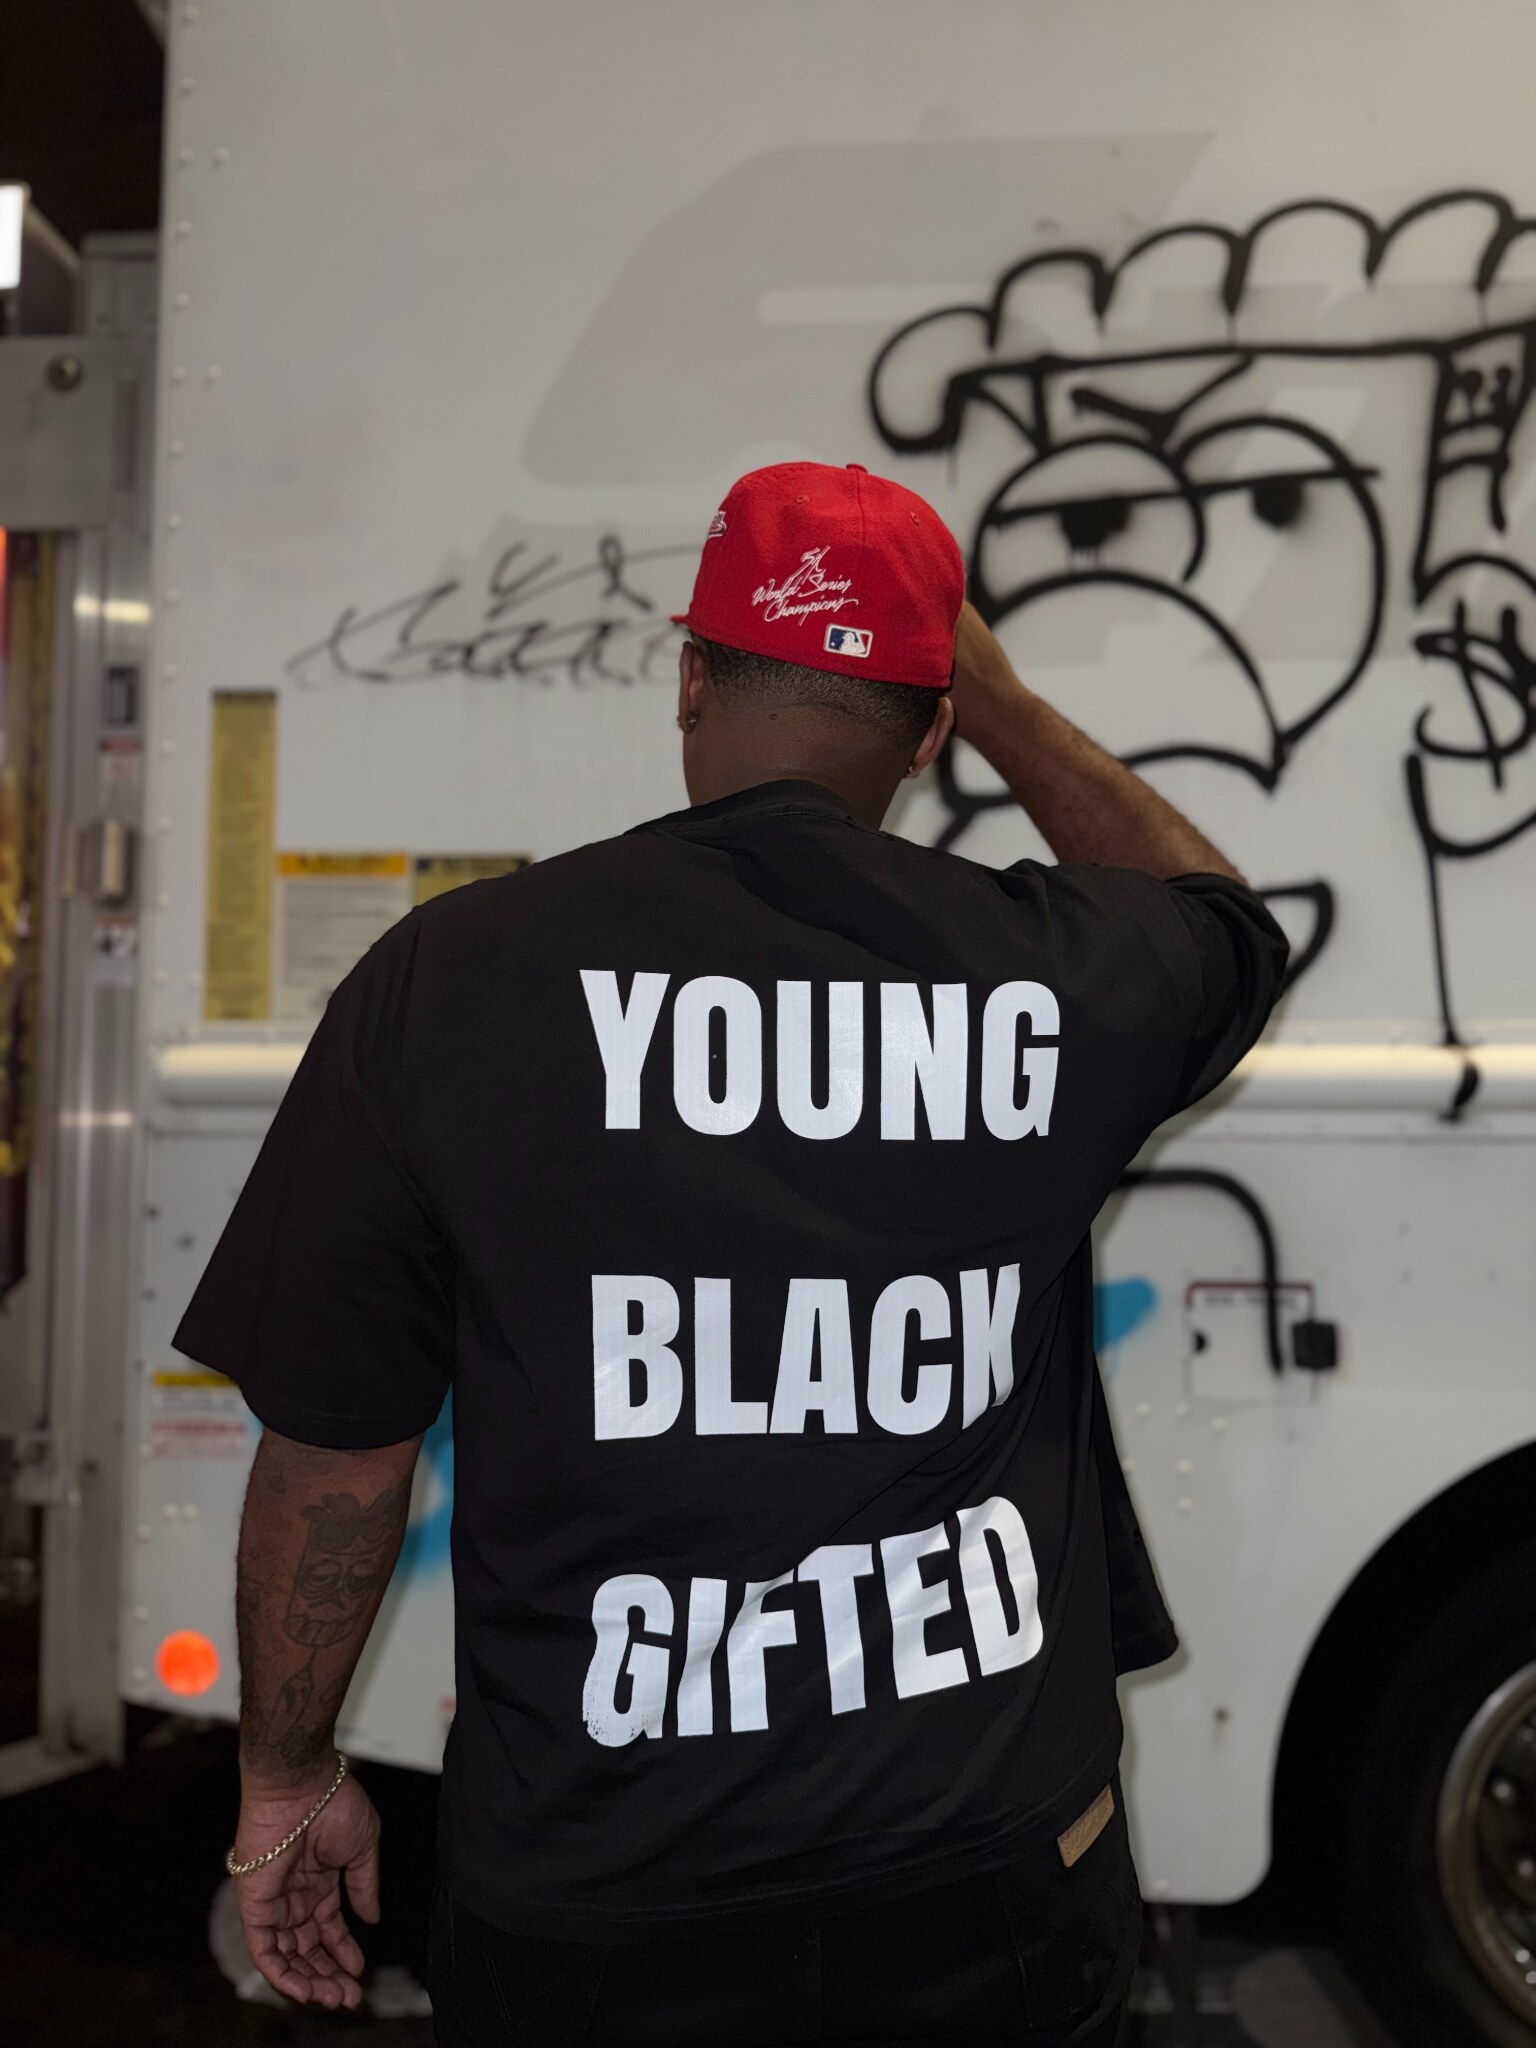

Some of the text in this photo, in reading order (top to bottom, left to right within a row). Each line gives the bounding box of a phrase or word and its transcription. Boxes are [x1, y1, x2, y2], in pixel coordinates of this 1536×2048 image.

[752, 569, 852, 606] World Series
[763, 595, 859, 626] Champions
[580, 970, 1060, 1141] YOUNG
[592, 1264, 1021, 1441] BLACK
[582, 1496, 1044, 1748] GIFTED
